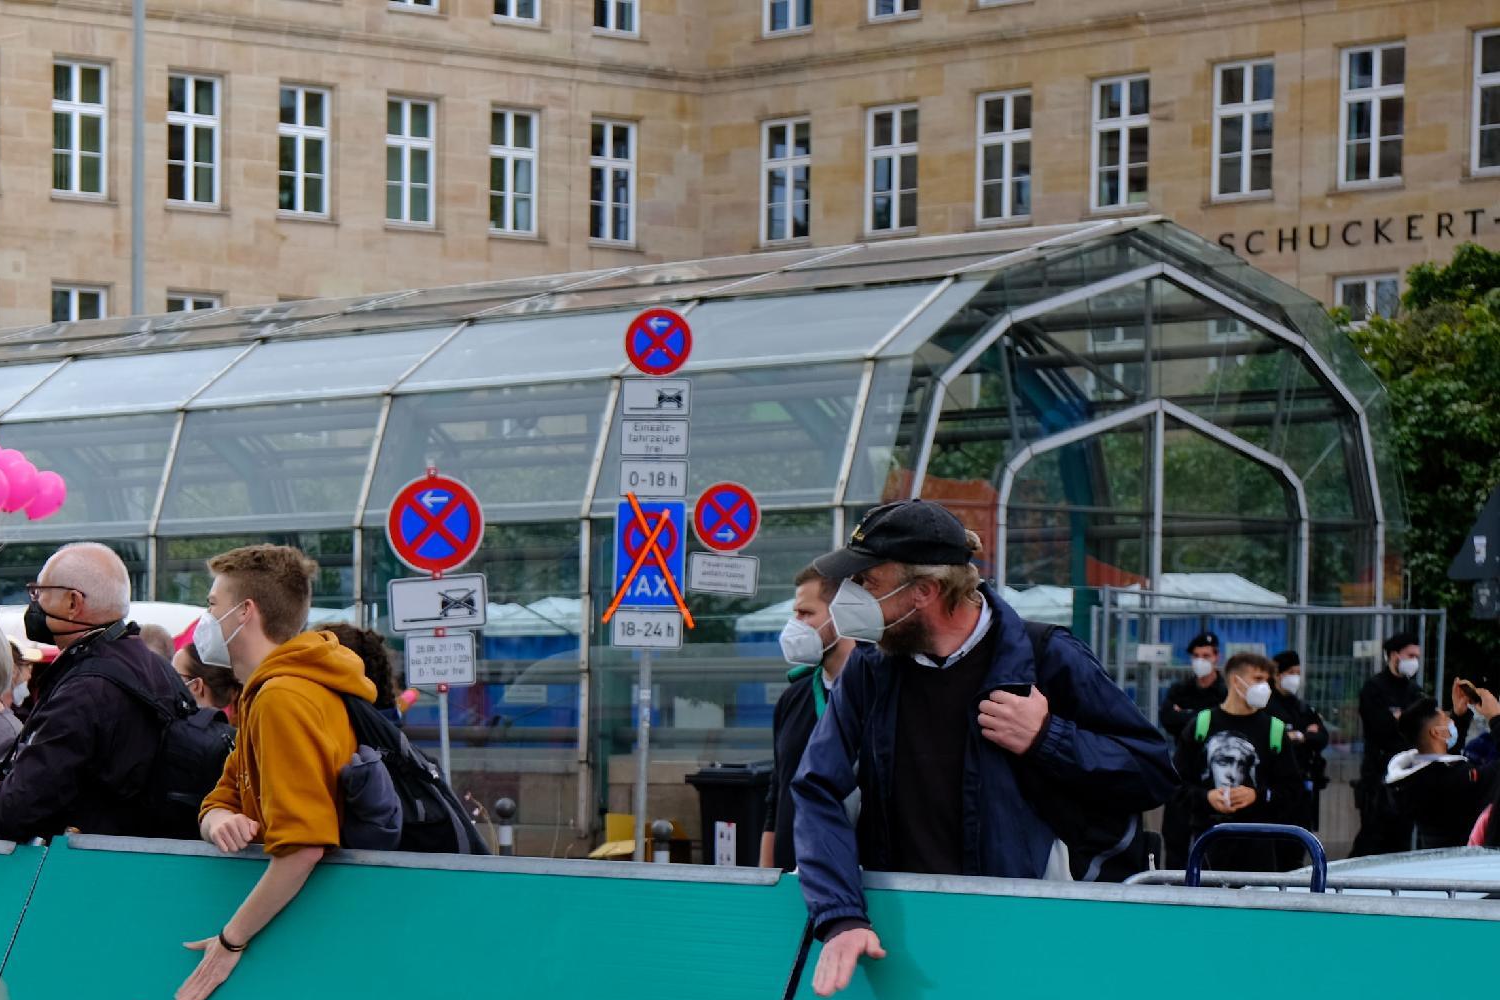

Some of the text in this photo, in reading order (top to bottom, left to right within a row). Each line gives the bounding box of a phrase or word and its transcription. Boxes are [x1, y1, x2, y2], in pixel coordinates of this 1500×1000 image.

[629, 470, 666, 487] 0-18
[621, 574, 676, 597] TAX
[620, 621, 675, 638] 18-24 h
